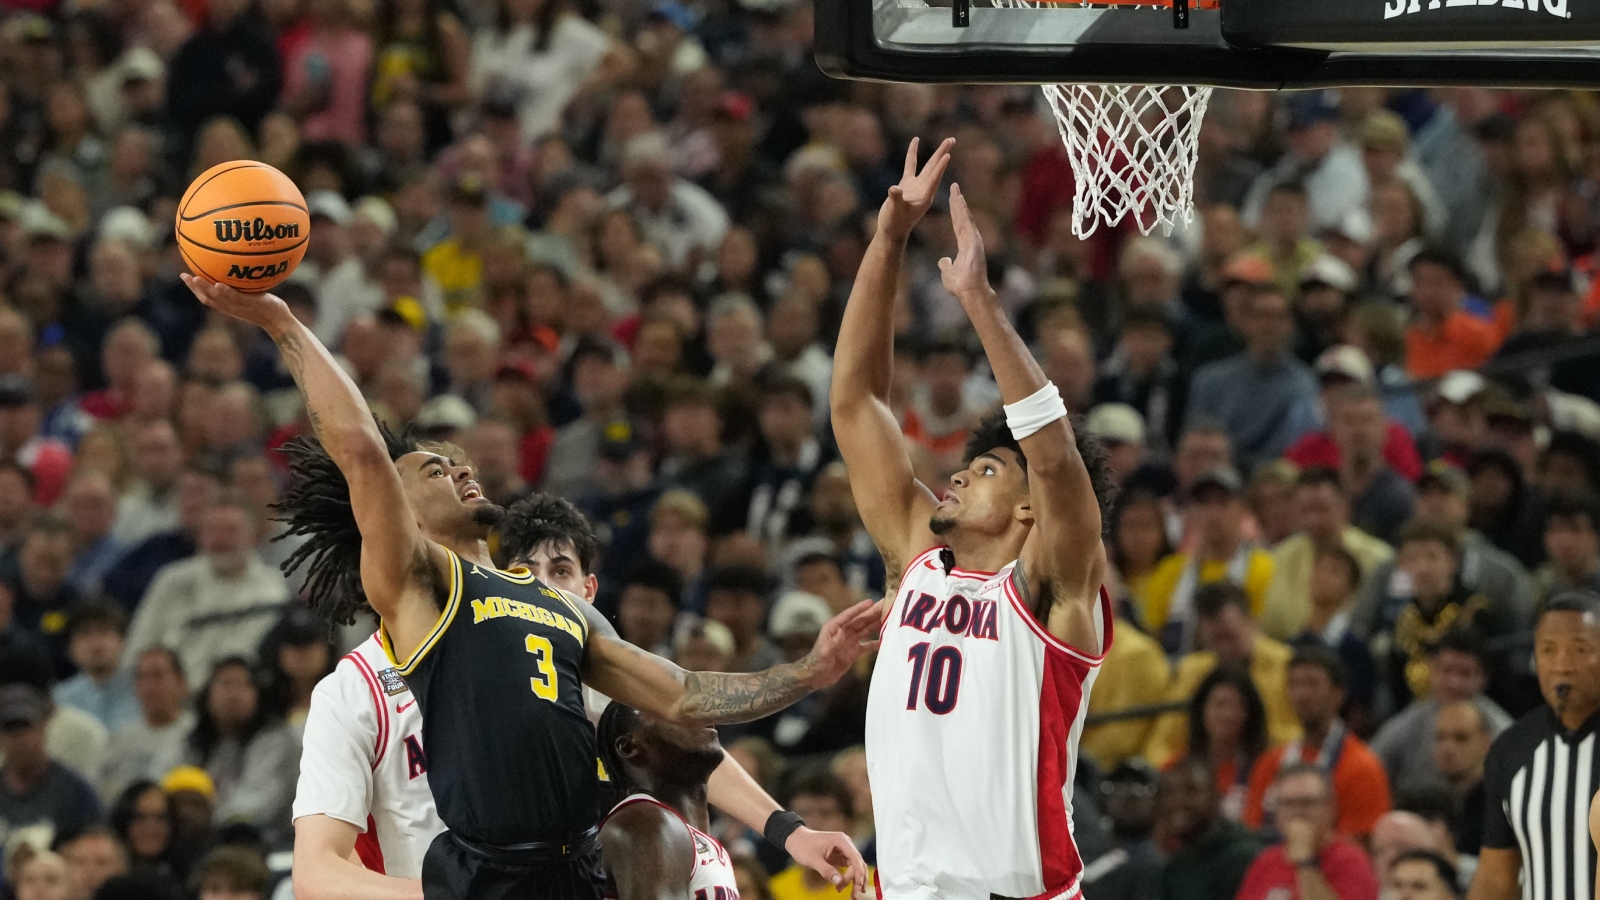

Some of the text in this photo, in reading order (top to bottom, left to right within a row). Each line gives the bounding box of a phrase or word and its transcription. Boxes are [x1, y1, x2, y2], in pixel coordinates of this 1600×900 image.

[213, 217, 299, 242] Wilson
[227, 259, 289, 280] NCAA
[470, 596, 584, 648] MICHIGAN
[899, 589, 999, 642] RIONA
[381, 671, 400, 681] FINAL
[387, 681, 405, 691] FOUR
[525, 633, 559, 703] 3
[906, 641, 963, 716] 10
